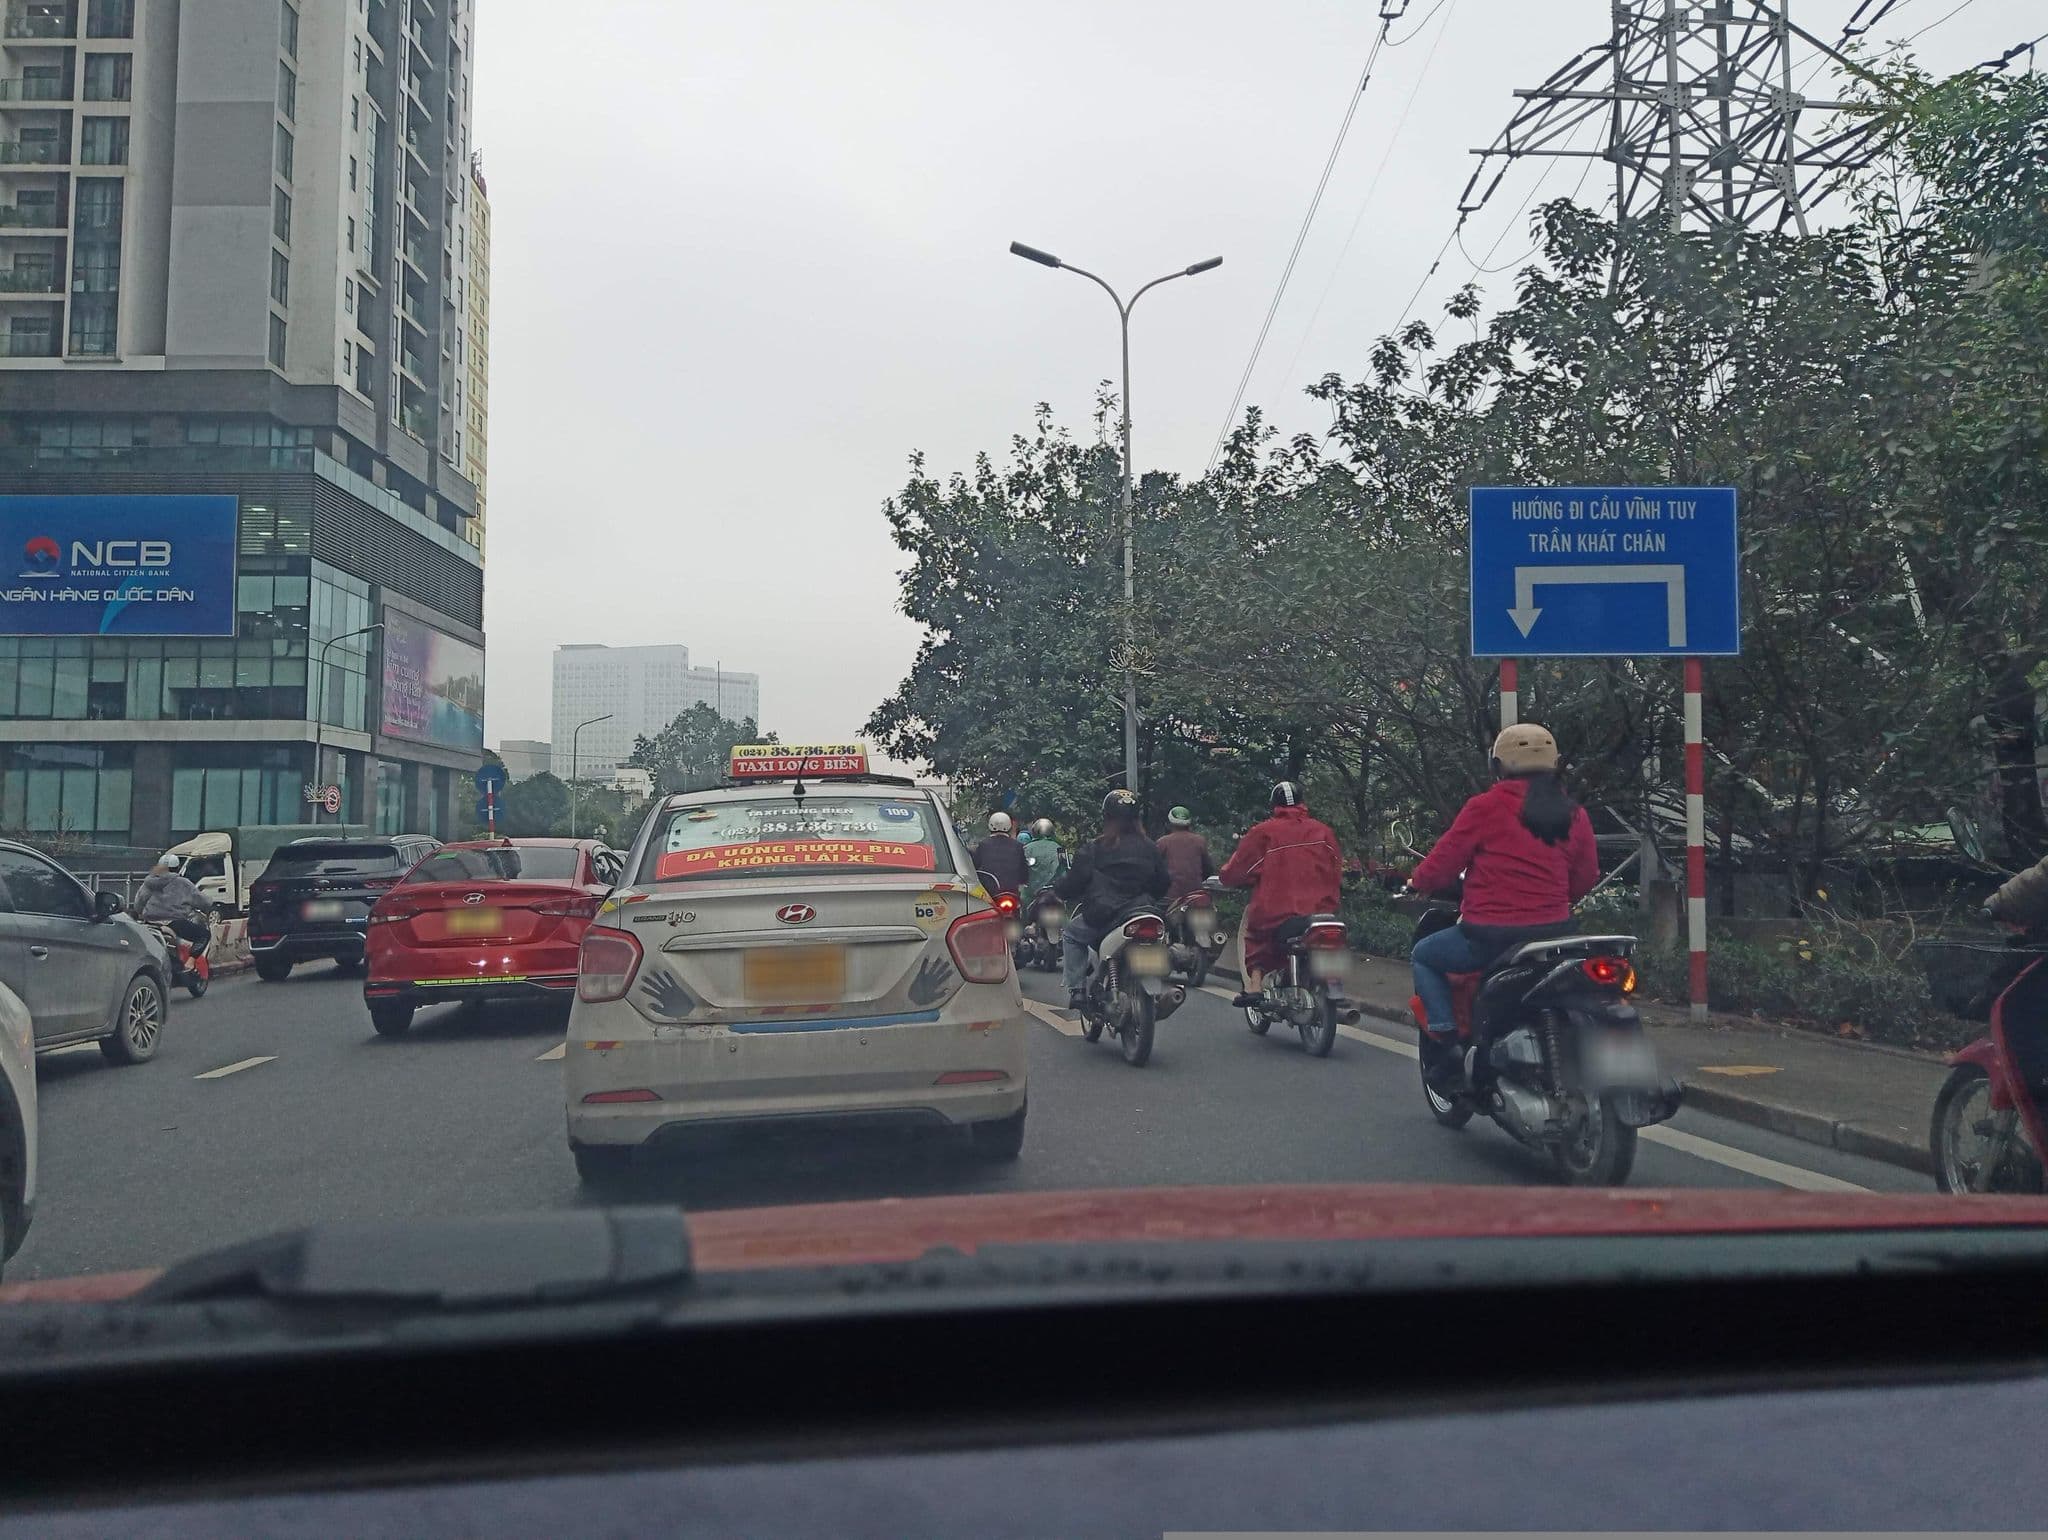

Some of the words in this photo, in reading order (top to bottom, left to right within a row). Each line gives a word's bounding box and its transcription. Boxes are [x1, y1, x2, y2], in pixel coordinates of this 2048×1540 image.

[1512, 496, 1563, 520] HƯỚNG
[1570, 501, 1584, 520] ĐI
[1590, 494, 1620, 520] CẦU
[1625, 496, 1661, 520] VĨNH
[1667, 500, 1697, 520] TUY
[1528, 527, 1571, 552] TRẦN
[1577, 529, 1616, 552] KHÁT
[1623, 530, 1666, 552] CHÂN
[71, 541, 172, 567] NCB
[71, 569, 111, 577] NATIONAL
[114, 569, 145, 577] CITIZEN
[148, 569, 170, 577] BANK
[0, 587, 47, 602] NGÂN
[50, 586, 100, 602] HÀNG
[103, 586, 153, 602] QUỐC
[156, 587, 195, 602] DÂN
[771, 745, 857, 757] 38.736.736
[737, 761, 775, 773] TAXI
[779, 759, 820, 772] LONG
[823, 757, 860, 770] BIÊN
[748, 809, 778, 817] TAXI
[885, 808, 909, 816] 109
[869, 845, 906, 855] BIA
[718, 854, 797, 868] KHÔNG
[804, 853, 840, 863] LÁI
[847, 854, 875, 863] XE
[915, 906, 934, 918] be
